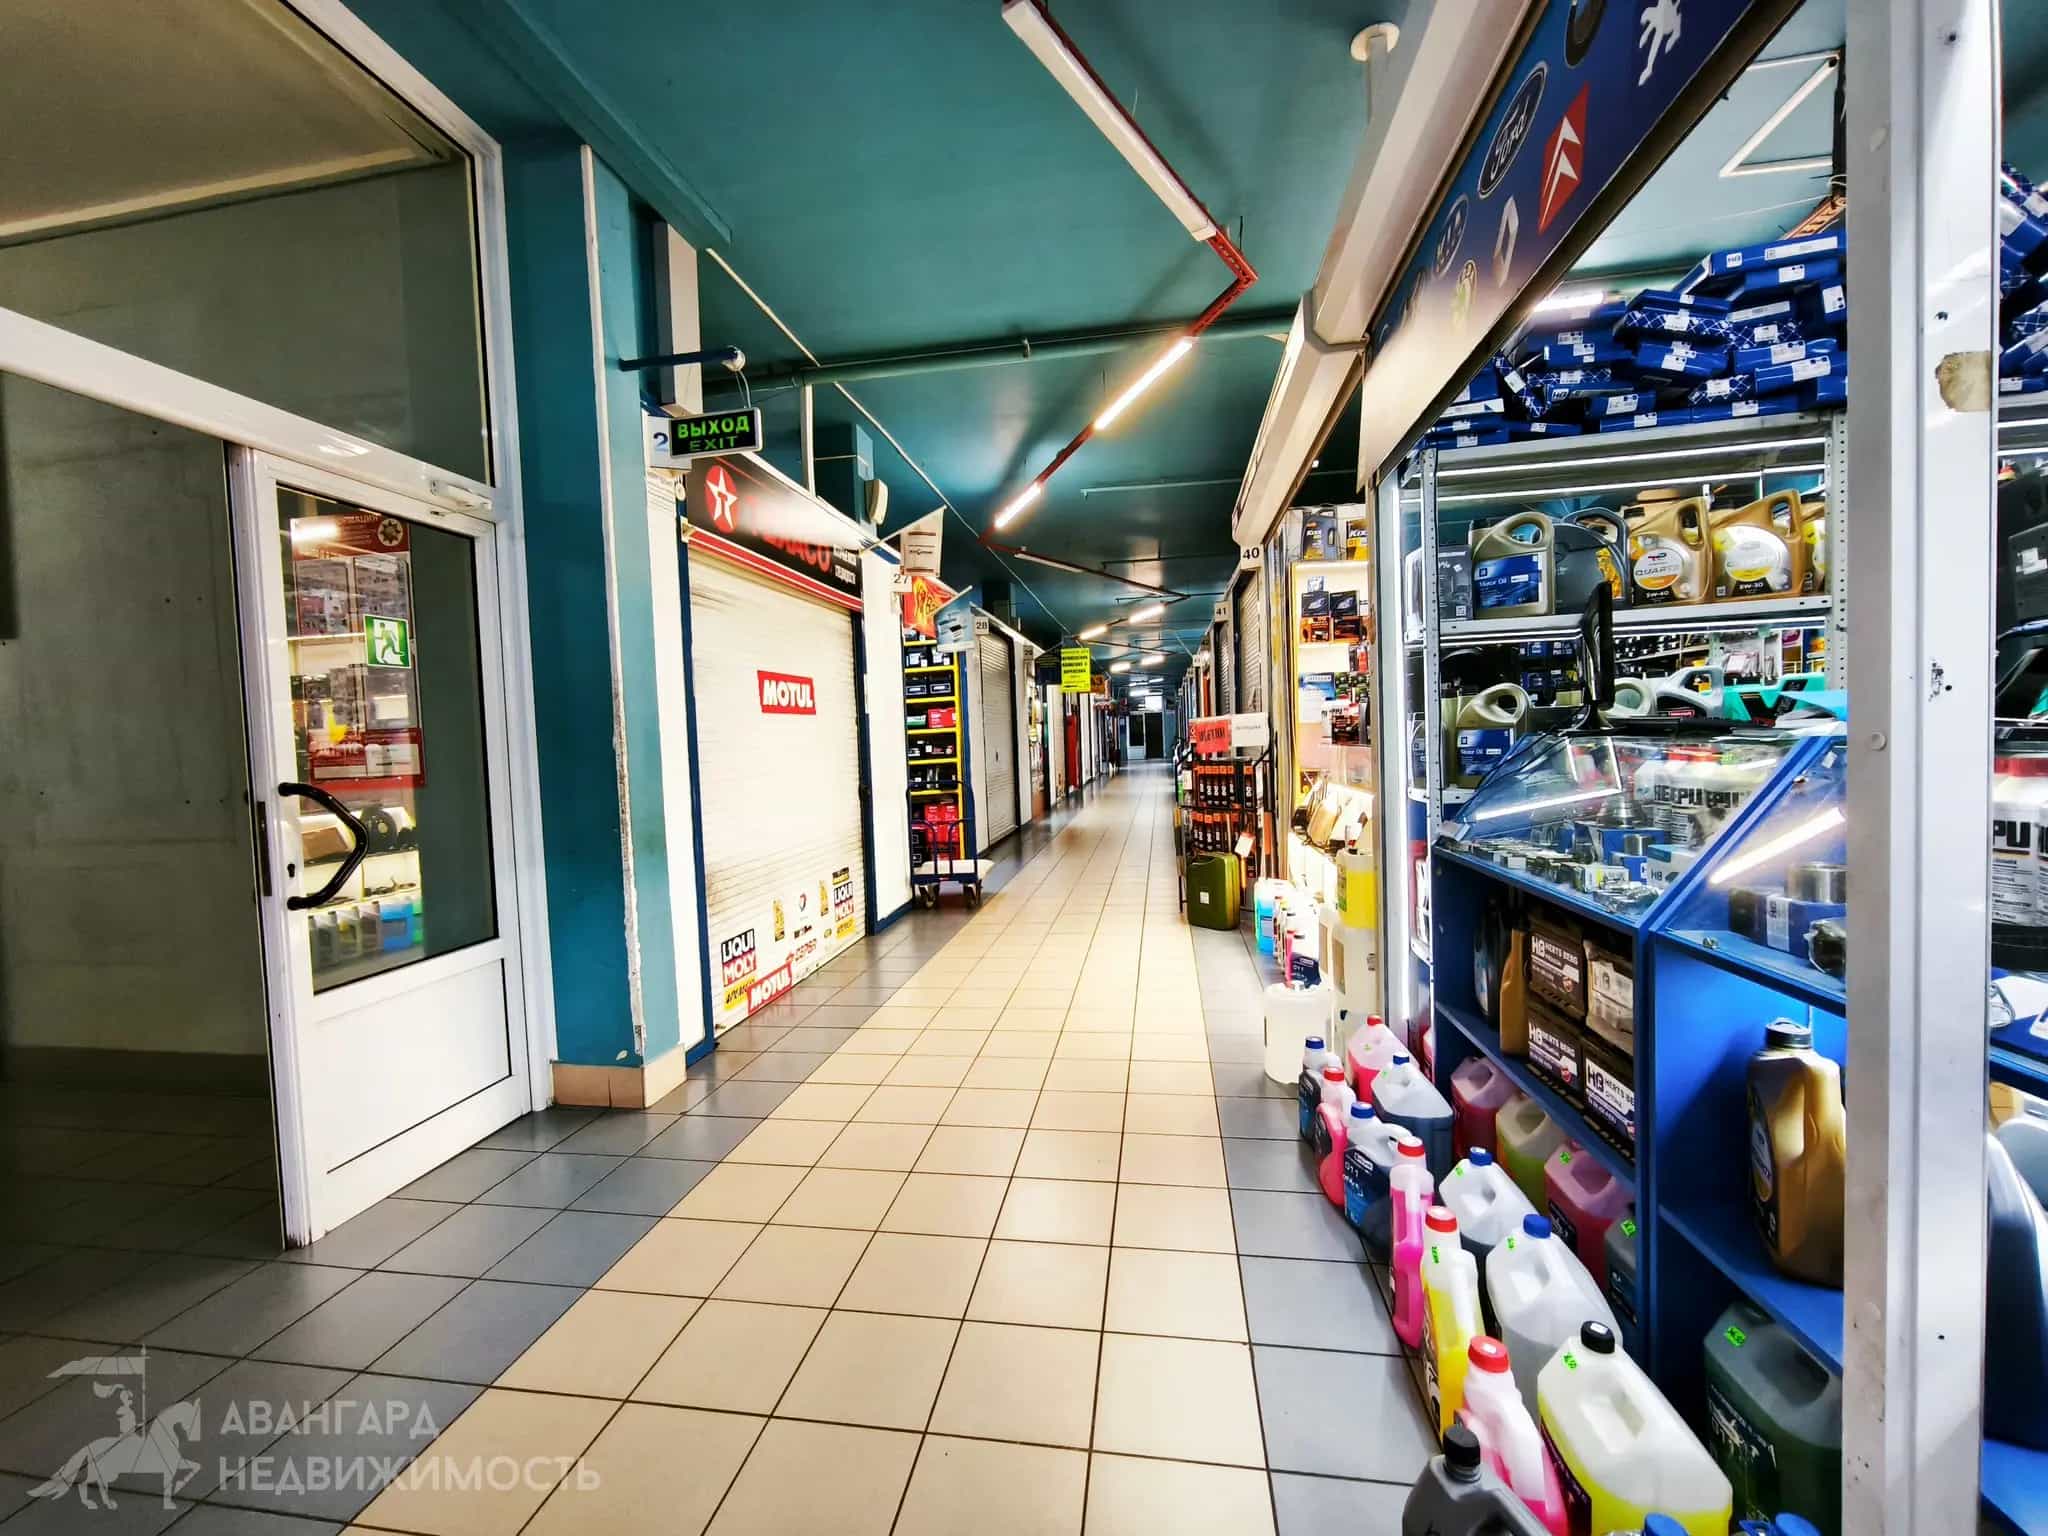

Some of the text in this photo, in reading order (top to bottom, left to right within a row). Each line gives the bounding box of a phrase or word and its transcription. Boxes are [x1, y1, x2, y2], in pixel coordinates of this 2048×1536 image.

[1491, 95, 1530, 181] Ford
[677, 415, 750, 439] ВЫХОД
[689, 435, 738, 451] EXIT
[1242, 547, 1259, 559] 40
[893, 573, 908, 584] 27
[762, 679, 814, 709] MOTUL
[721, 929, 755, 962] LIQUI
[723, 951, 756, 986] MOLY
[750, 967, 792, 1011] MOTUL
[1587, 1063, 1605, 1093] HB
